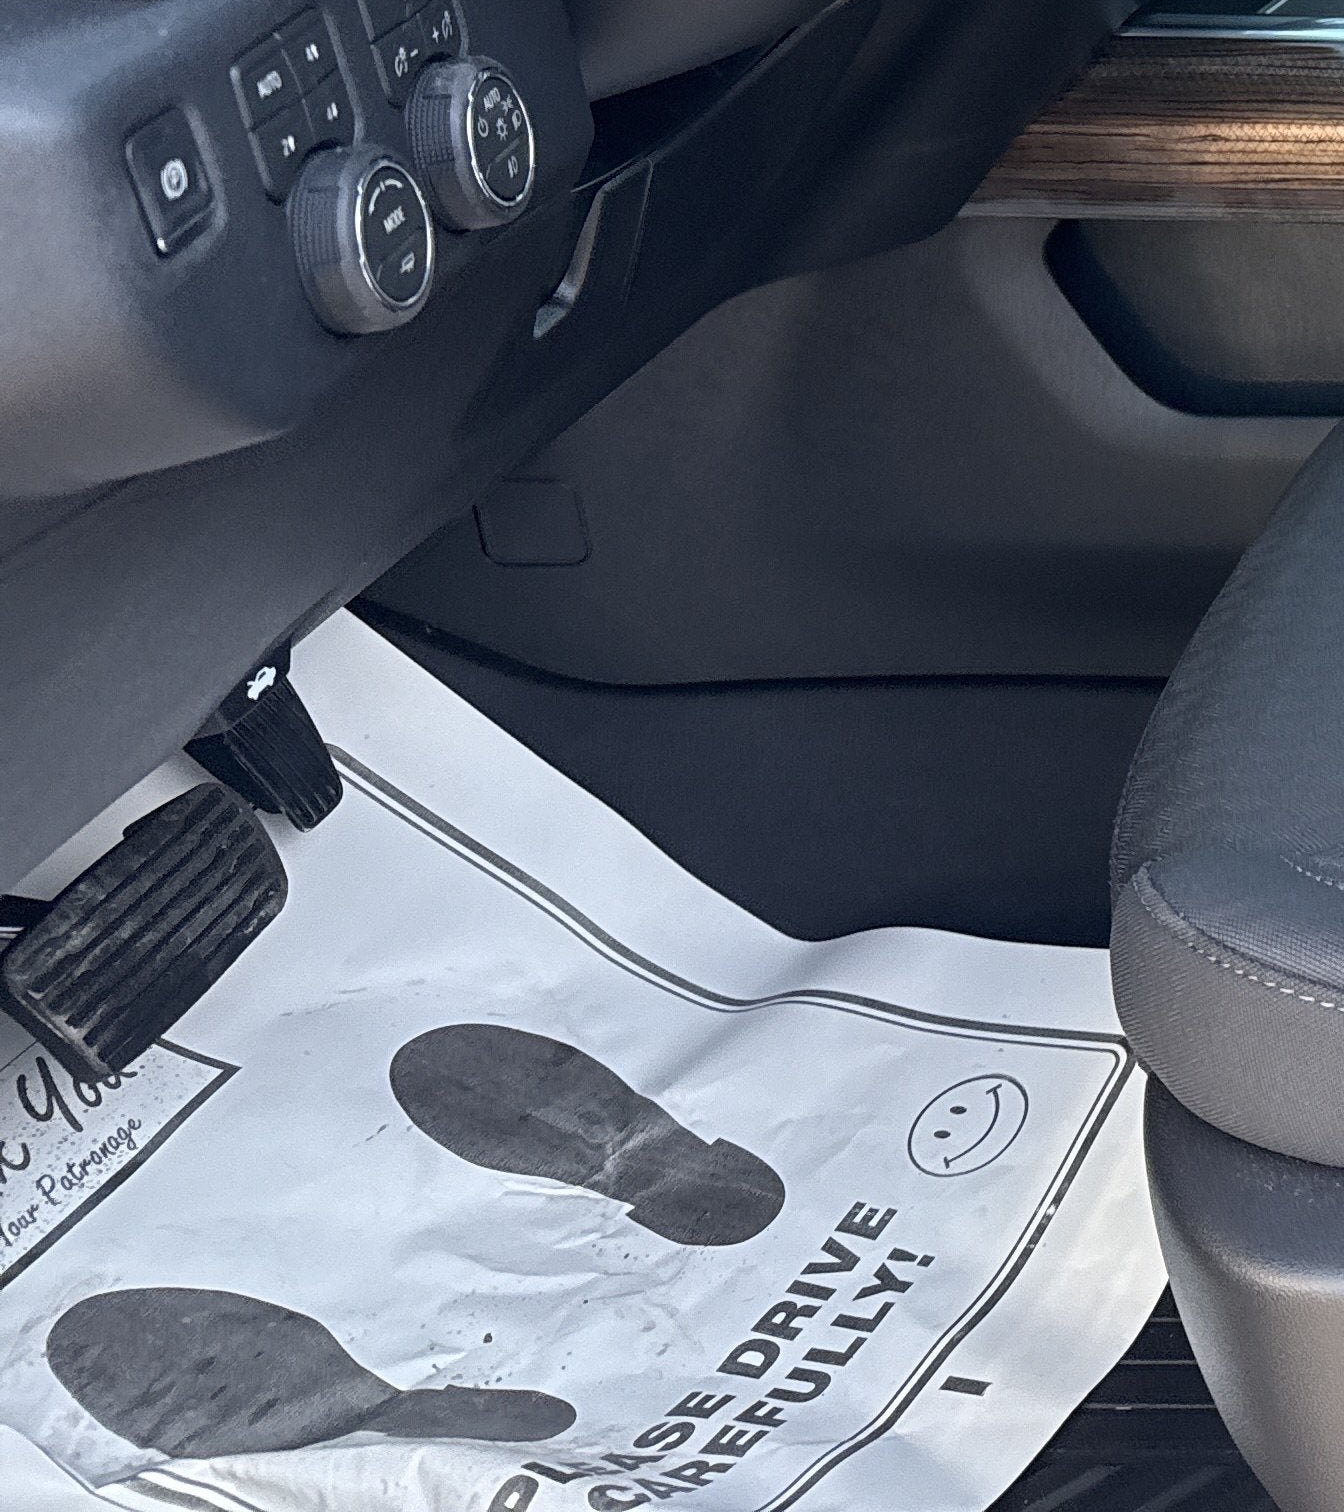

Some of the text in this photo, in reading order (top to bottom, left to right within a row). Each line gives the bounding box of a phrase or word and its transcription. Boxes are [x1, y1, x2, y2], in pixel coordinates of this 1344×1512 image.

[383, 205, 406, 235] MODE
[35, 1117, 142, 1206] Patronage
[715, 1200, 898, 1379] DRIVE
[587, 1247, 936, 1512] CAREFULLY!
